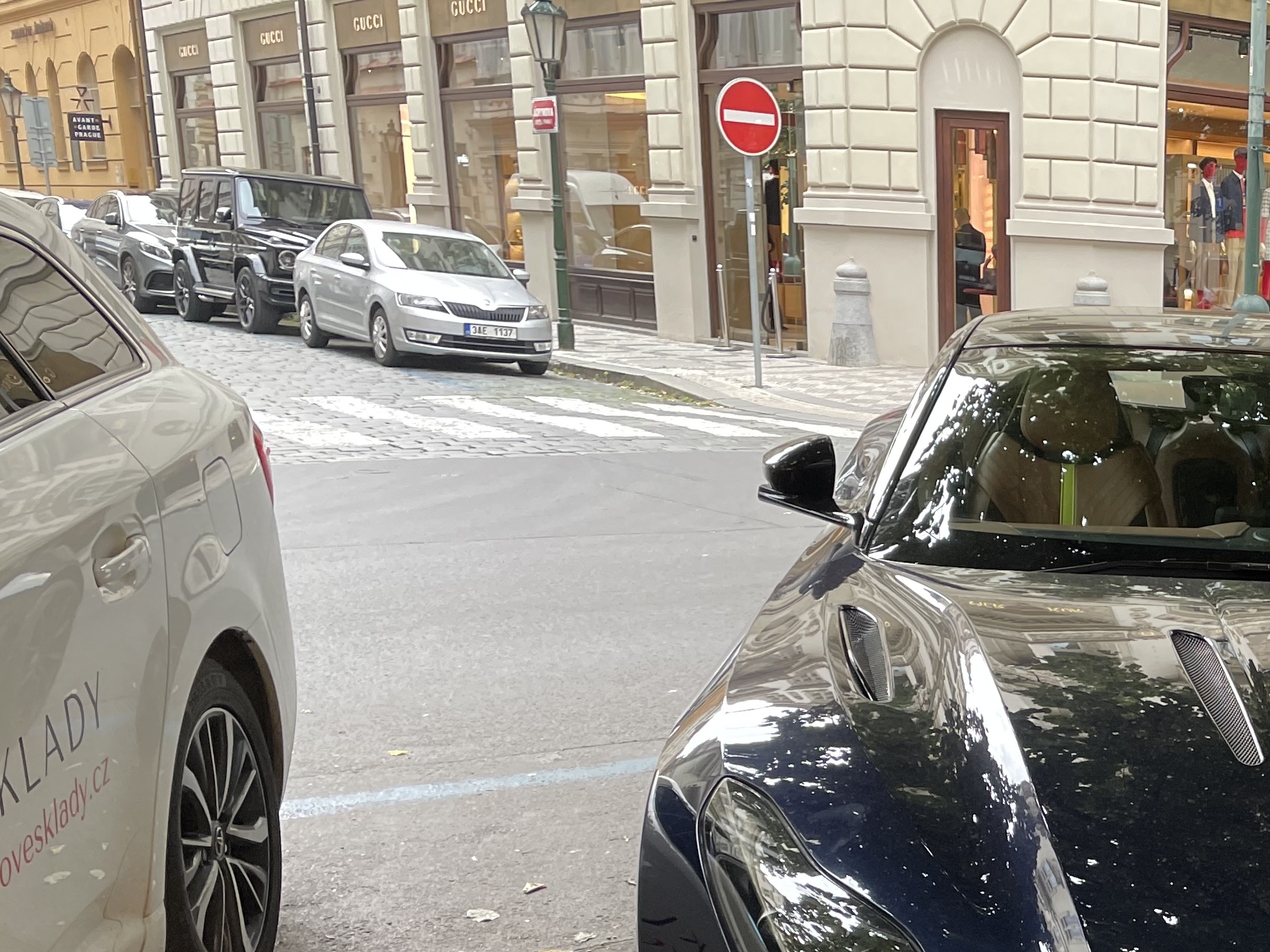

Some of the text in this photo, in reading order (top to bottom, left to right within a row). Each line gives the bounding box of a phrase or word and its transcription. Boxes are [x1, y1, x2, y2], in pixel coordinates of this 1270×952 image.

[450, 0, 487, 17] GUCCI
[353, 14, 383, 32] GUCCI
[260, 29, 284, 46] GUCCI
[178, 44, 199, 58] GUCCI
[74, 131, 102, 139] PRAGUE
[472, 325, 487, 335] 3AE
[494, 327, 513, 337] 1137
